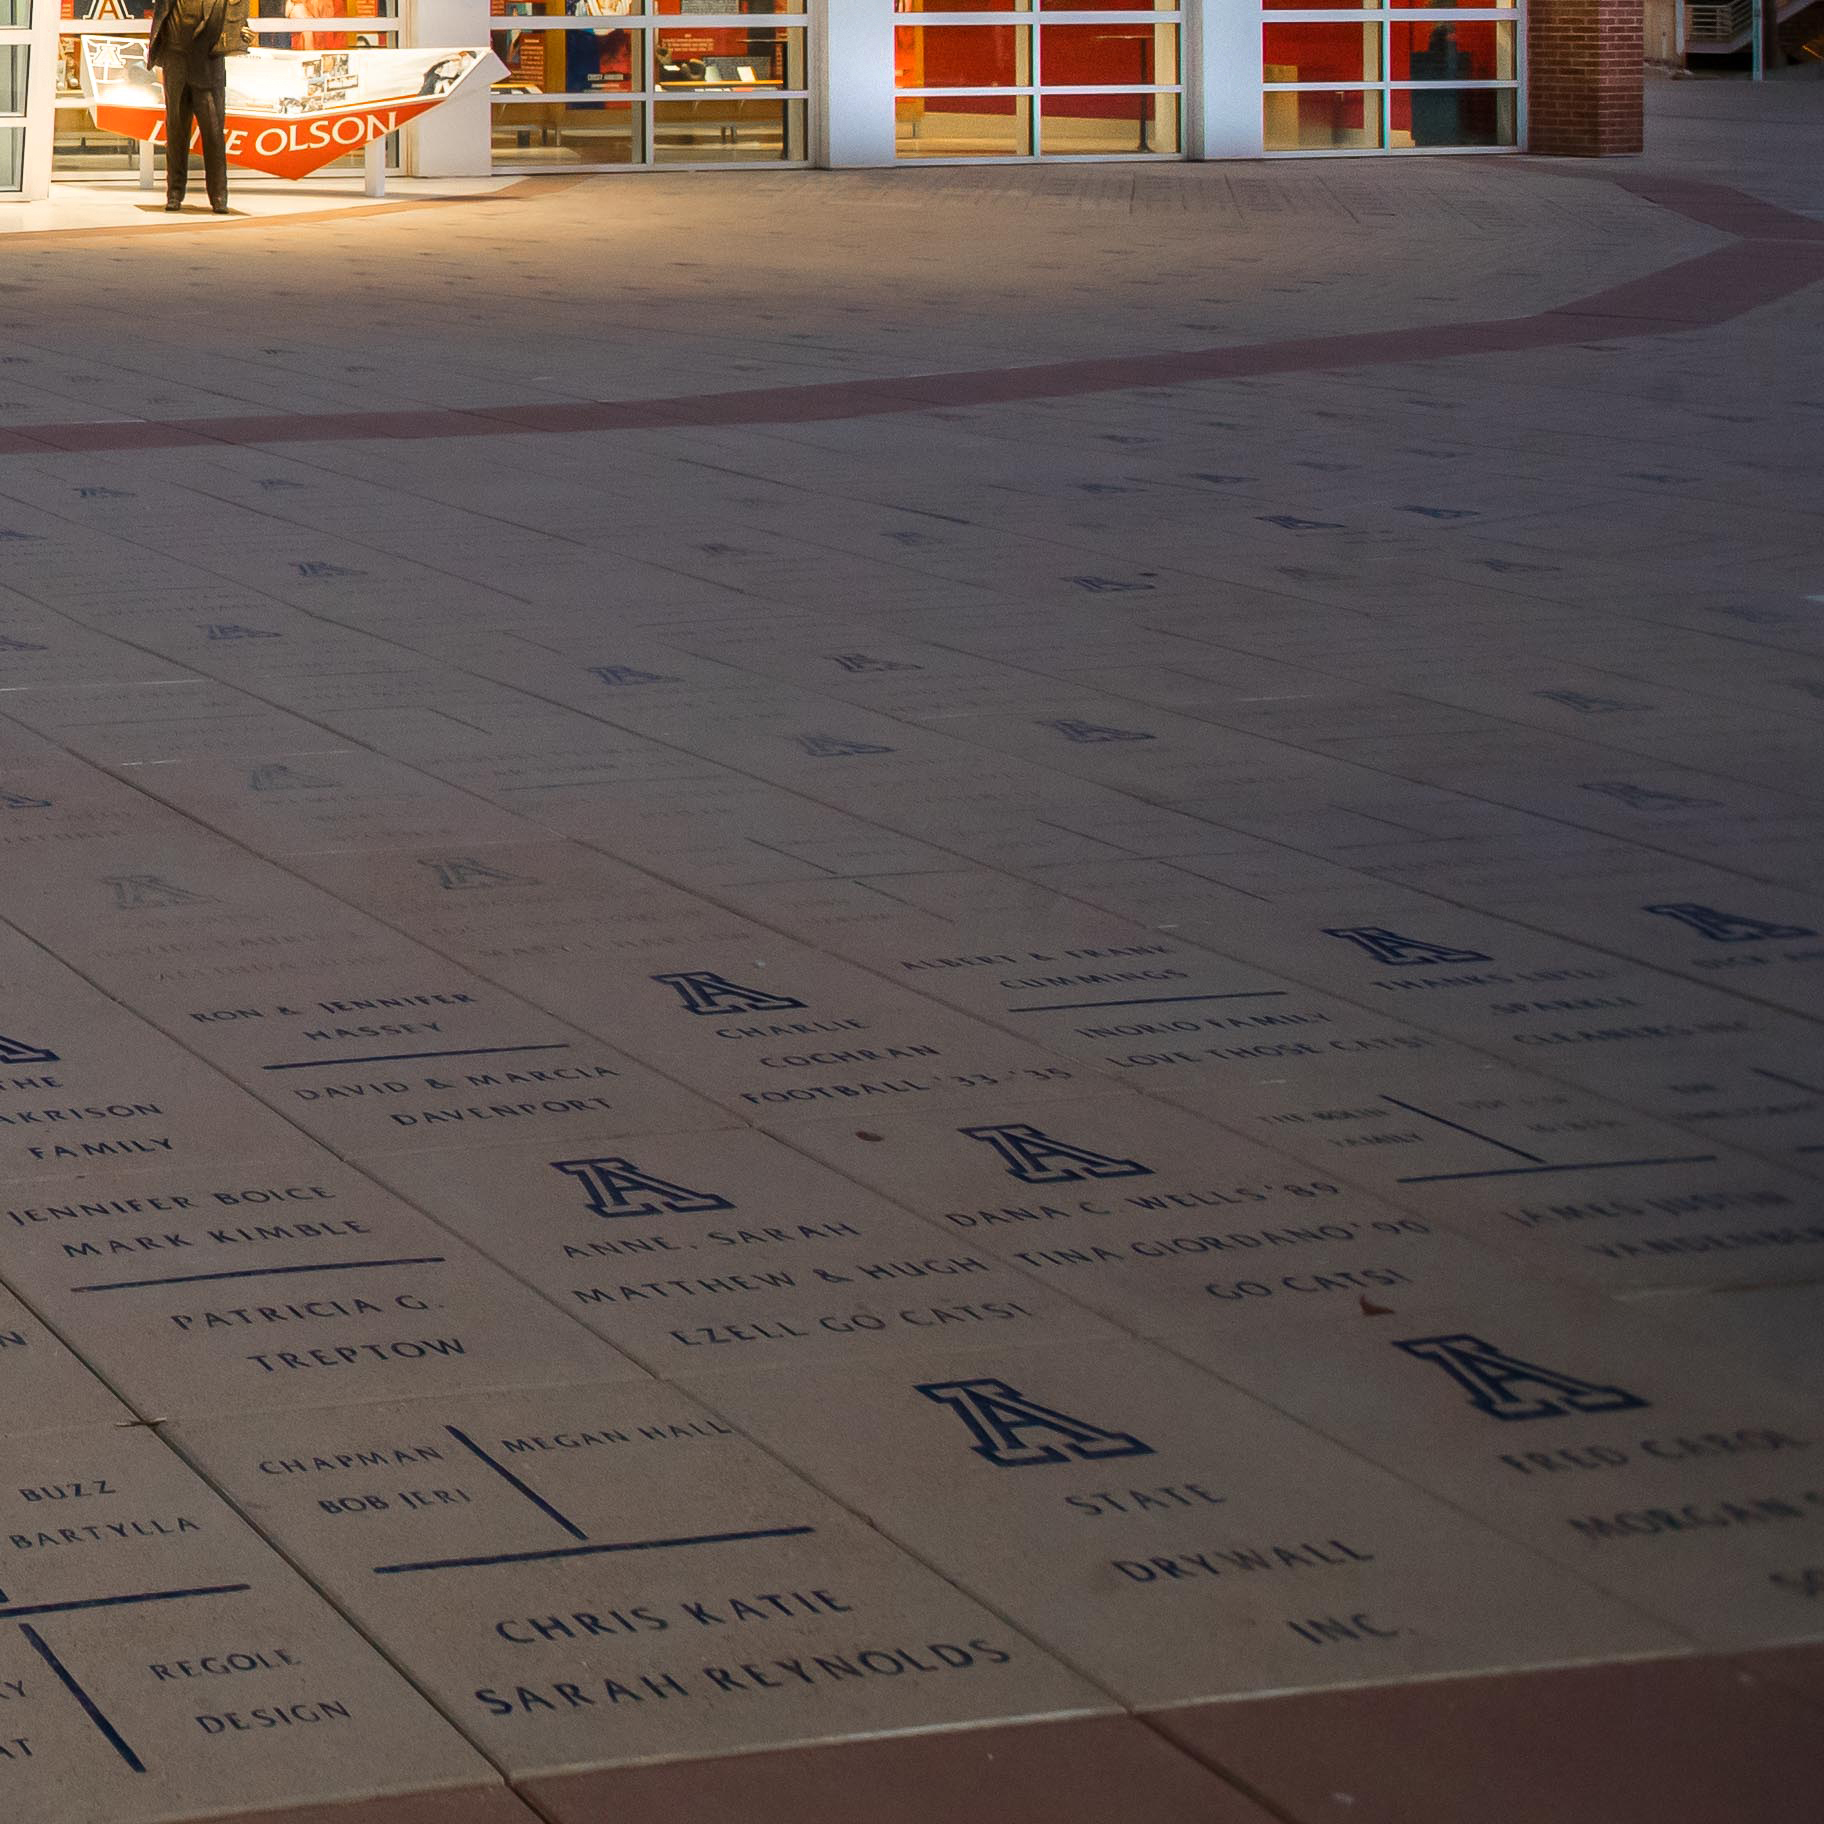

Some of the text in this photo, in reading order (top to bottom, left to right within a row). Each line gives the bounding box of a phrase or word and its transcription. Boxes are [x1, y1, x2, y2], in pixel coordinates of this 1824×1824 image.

[254, 110, 397, 158] OLSON
[899, 944, 1175, 972] ALBERT & FRANK
[1323, 926, 1494, 965] A
[651, 971, 808, 1015] A
[998, 968, 1190, 990] CUMMINGS
[187, 992, 479, 1024] RON & JENNIFER
[1204, 1011, 1333, 1030] FAMILY
[301, 1020, 443, 1042] HASSEY
[714, 1018, 871, 1040] CHARLIE
[758, 1044, 942, 1069] COCHRAN
[1105, 1041, 1325, 1069] LOVE THOSE
[292, 1065, 621, 1102] DAVID & MARCIA
[738, 1079, 932, 1106] FOOTBALL
[388, 1096, 613, 1127] DAVENPORT
[26, 1136, 174, 1161] FAMILY
[956, 1123, 1156, 1184] A
[551, 1157, 736, 1218] A
[5, 1185, 337, 1229] JENNIFER BOICE
[943, 1204, 1072, 1229] DANA
[60, 1219, 373, 1259] MARK KIMBLE
[706, 1220, 863, 1247] SARAH
[1011, 1245, 1127, 1268] TINA
[570, 1256, 990, 1306] MATTHEW & HUGH
[1203, 1279, 1274, 1302] GO
[169, 1297, 386, 1333] PATRICIA
[667, 1303, 888, 1347] EZELL GO
[245, 1336, 472, 1374] TREPTOW
[1390, 1334, 1652, 1420] A
[910, 1376, 1158, 1470] A
[257, 1420, 734, 1476] CHAPMAN MEGAN HALL
[1496, 1444, 1630, 1477] FRED
[17, 1478, 118, 1504] BUZZ
[316, 1487, 473, 1516] BOB JERI
[1063, 1482, 1228, 1517] STATE
[7, 1516, 202, 1551] BARTYLLA
[1566, 1497, 1806, 1538] MORGAN
[1105, 1538, 1376, 1584] DRYWALL
[493, 1588, 855, 1646] CHRIS KATIE
[147, 1647, 302, 1683] REGOLE
[473, 1637, 1013, 1717] SARAH REYNOLDS
[193, 1698, 353, 1737] DESIGN
